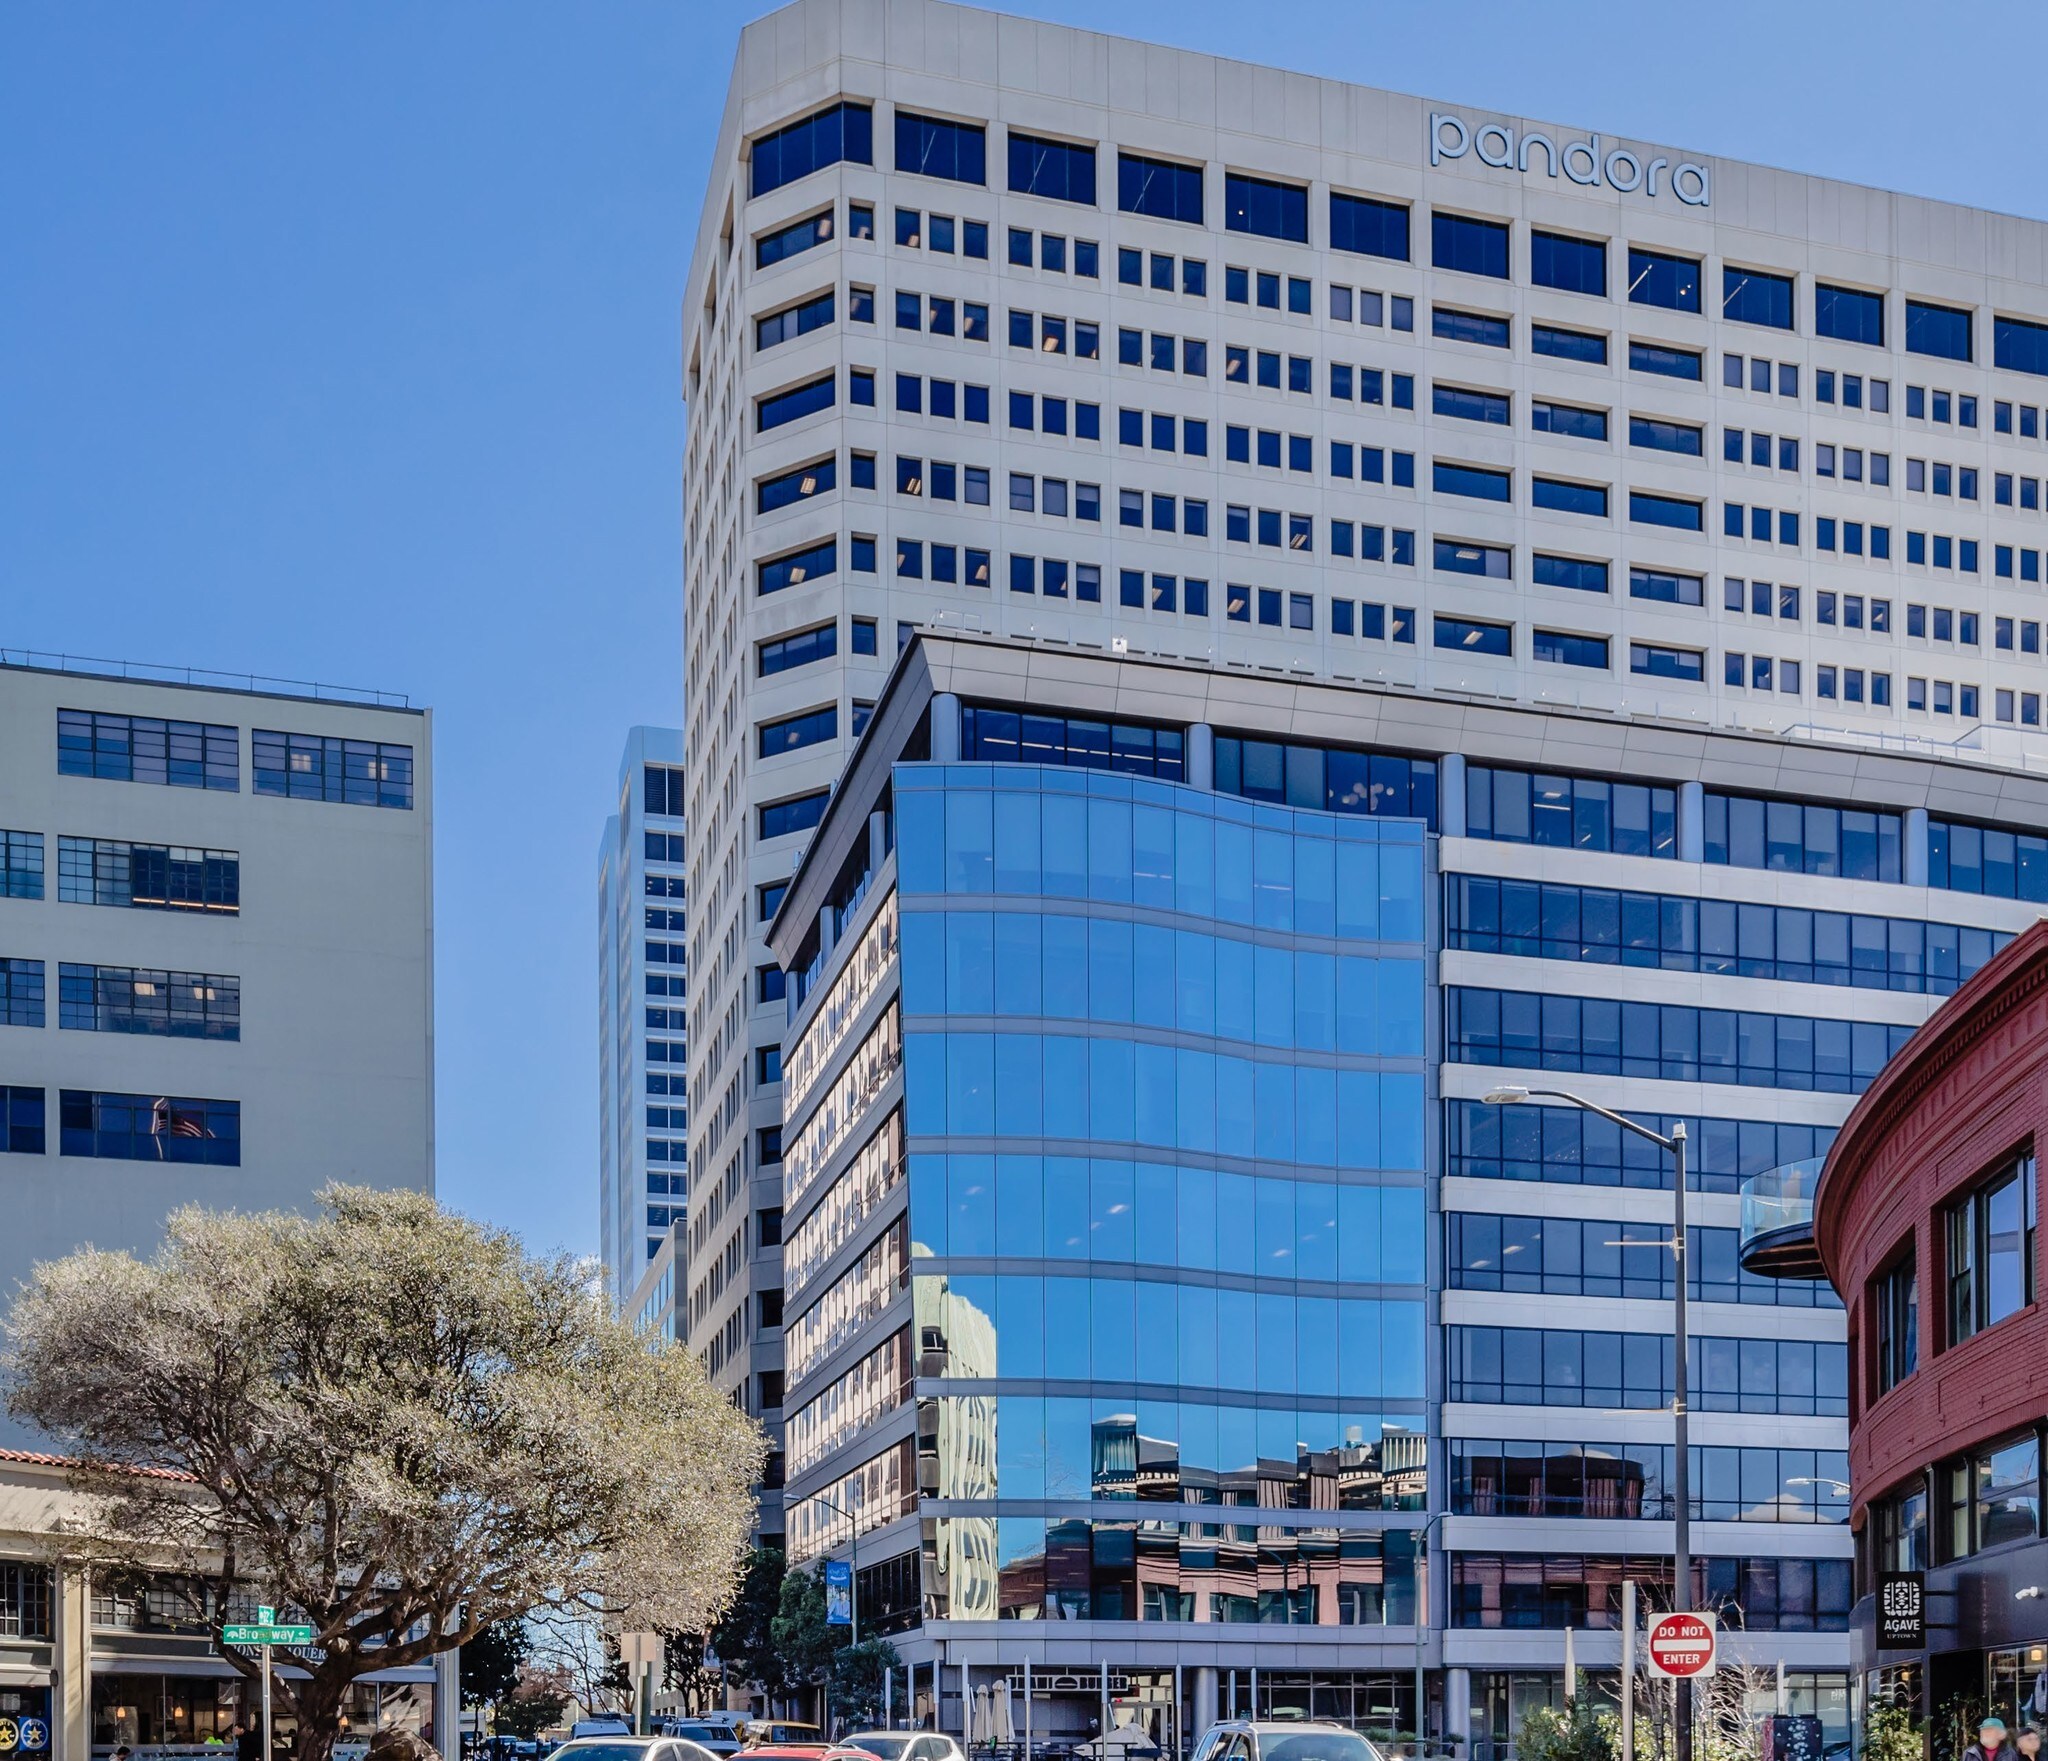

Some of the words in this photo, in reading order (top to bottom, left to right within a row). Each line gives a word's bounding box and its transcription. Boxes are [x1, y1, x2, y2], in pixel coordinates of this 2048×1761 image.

[1430, 112, 1710, 207] pandora
[1659, 1626, 1676, 1637] DO
[1681, 1626, 1705, 1637] NOT
[1884, 1619, 1920, 1633] AGAVE
[239, 1627, 294, 1643] Broway
[1663, 1653, 1700, 1664] ENTER
